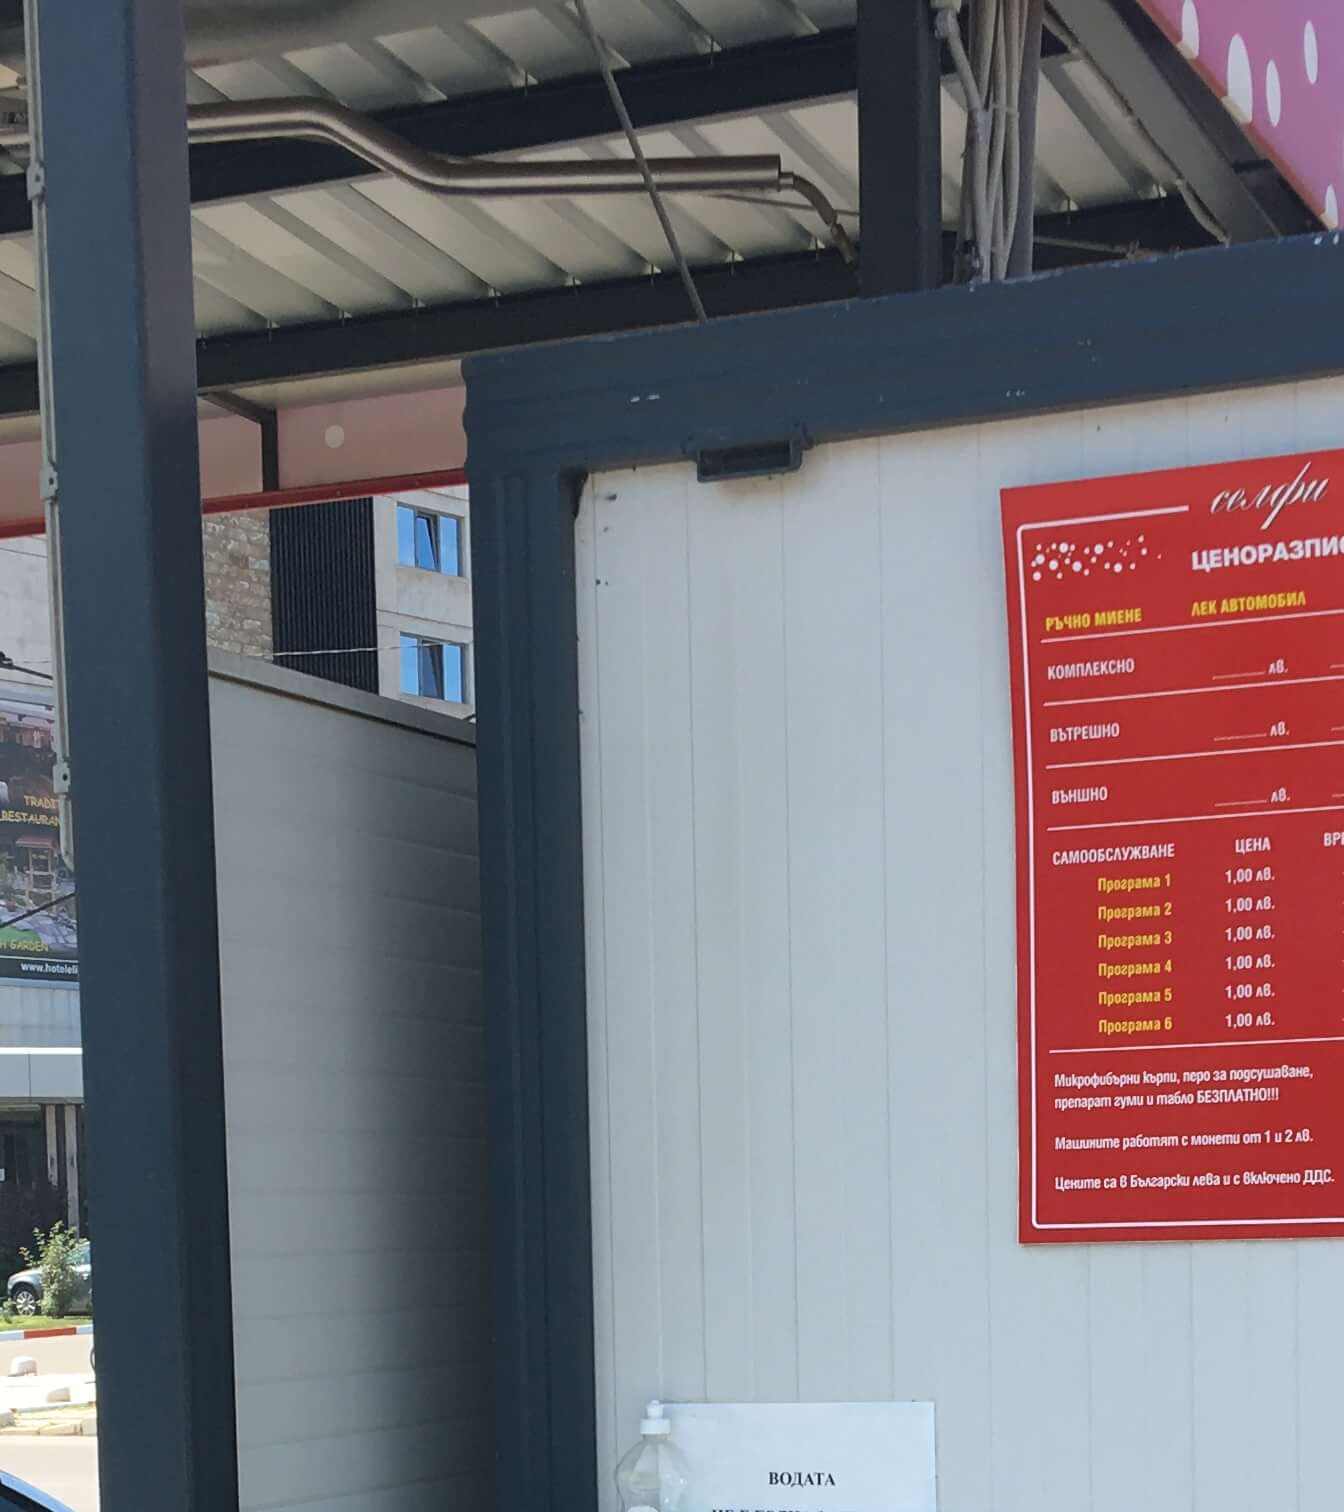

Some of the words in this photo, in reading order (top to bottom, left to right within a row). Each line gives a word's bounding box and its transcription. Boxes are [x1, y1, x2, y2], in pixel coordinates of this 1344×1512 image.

[1045, 612, 1090, 632] РЪЧНО
[1094, 608, 1143, 627] МИЕНЕ
[1191, 598, 1217, 617] ЛЕК
[1220, 591, 1307, 614] АВТОМОБИЛ
[1047, 657, 1136, 681] КОМПЛЕКСНО
[1050, 722, 1121, 743] ВЪТРЕШНО
[1051, 786, 1109, 805] ВЪНШНО
[1052, 843, 1176, 865] САМООБСЛУЖВАНЕ
[1234, 837, 1271, 854] ЦЕНА
[1097, 877, 1161, 893] Програма
[1164, 873, 1173, 887] 1
[1224, 868, 1253, 885] 1,00
[1256, 866, 1276, 882] лв.
[1097, 905, 1161, 922] Програма
[1164, 902, 1173, 916] 2
[1224, 897, 1253, 913] 1,00
[1256, 896, 1276, 911] лв.
[1097, 934, 1161, 950] Програма
[1164, 931, 1173, 945] 3
[1224, 926, 1253, 942] 1,00
[1256, 925, 1276, 940] лв.
[1097, 963, 1161, 979] Програма
[1164, 959, 1173, 973] 4
[1224, 955, 1253, 971] 1,00
[1256, 953, 1276, 969] лв.
[1097, 991, 1161, 1007] Програма
[1164, 988, 1173, 1002] 5
[1224, 984, 1253, 1000] 1,00
[1256, 982, 1276, 997] лв.
[1097, 1019, 1161, 1035] Програма
[1164, 1016, 1173, 1030] 6
[1224, 1012, 1253, 1029] 1,00
[1256, 1011, 1276, 1026] лв.
[1054, 1072, 1141, 1089] Микрофибърни
[1143, 1070, 1181, 1086] кърпи,
[1183, 1070, 1210, 1084] перо
[1213, 1070, 1227, 1081] за
[1229, 1065, 1314, 1082] подсушаване,
[1054, 1096, 1112, 1112] препарат
[1114, 1095, 1144, 1109] гуми
[1146, 1096, 1154, 1105] и
[1156, 1091, 1194, 1105] табло
[1197, 1087, 1279, 1103] БЕЗПЛАТНО!!!
[1054, 1136, 1120, 1150] Машините
[1122, 1134, 1179, 1151] работят
[1181, 1135, 1188, 1146] с
[1190, 1133, 1241, 1146] монети
[1242, 1132, 1262, 1144] от
[1264, 1130, 1271, 1143] 1
[1274, 1132, 1283, 1143] и
[1284, 1129, 1294, 1143] 2
[1295, 1128, 1314, 1142] лв.
[1054, 1176, 1101, 1192] Цените
[1103, 1177, 1117, 1189] са
[1119, 1175, 1128, 1189] в
[1130, 1173, 1190, 1190] Български
[1192, 1172, 1221, 1186] лева
[1223, 1173, 1231, 1186] и
[1233, 1173, 1241, 1185] с
[1243, 1171, 1301, 1185] включено
[1302, 1169, 1335, 1185] ДДС.
[768, 1471, 836, 1487] ВОДАТА
